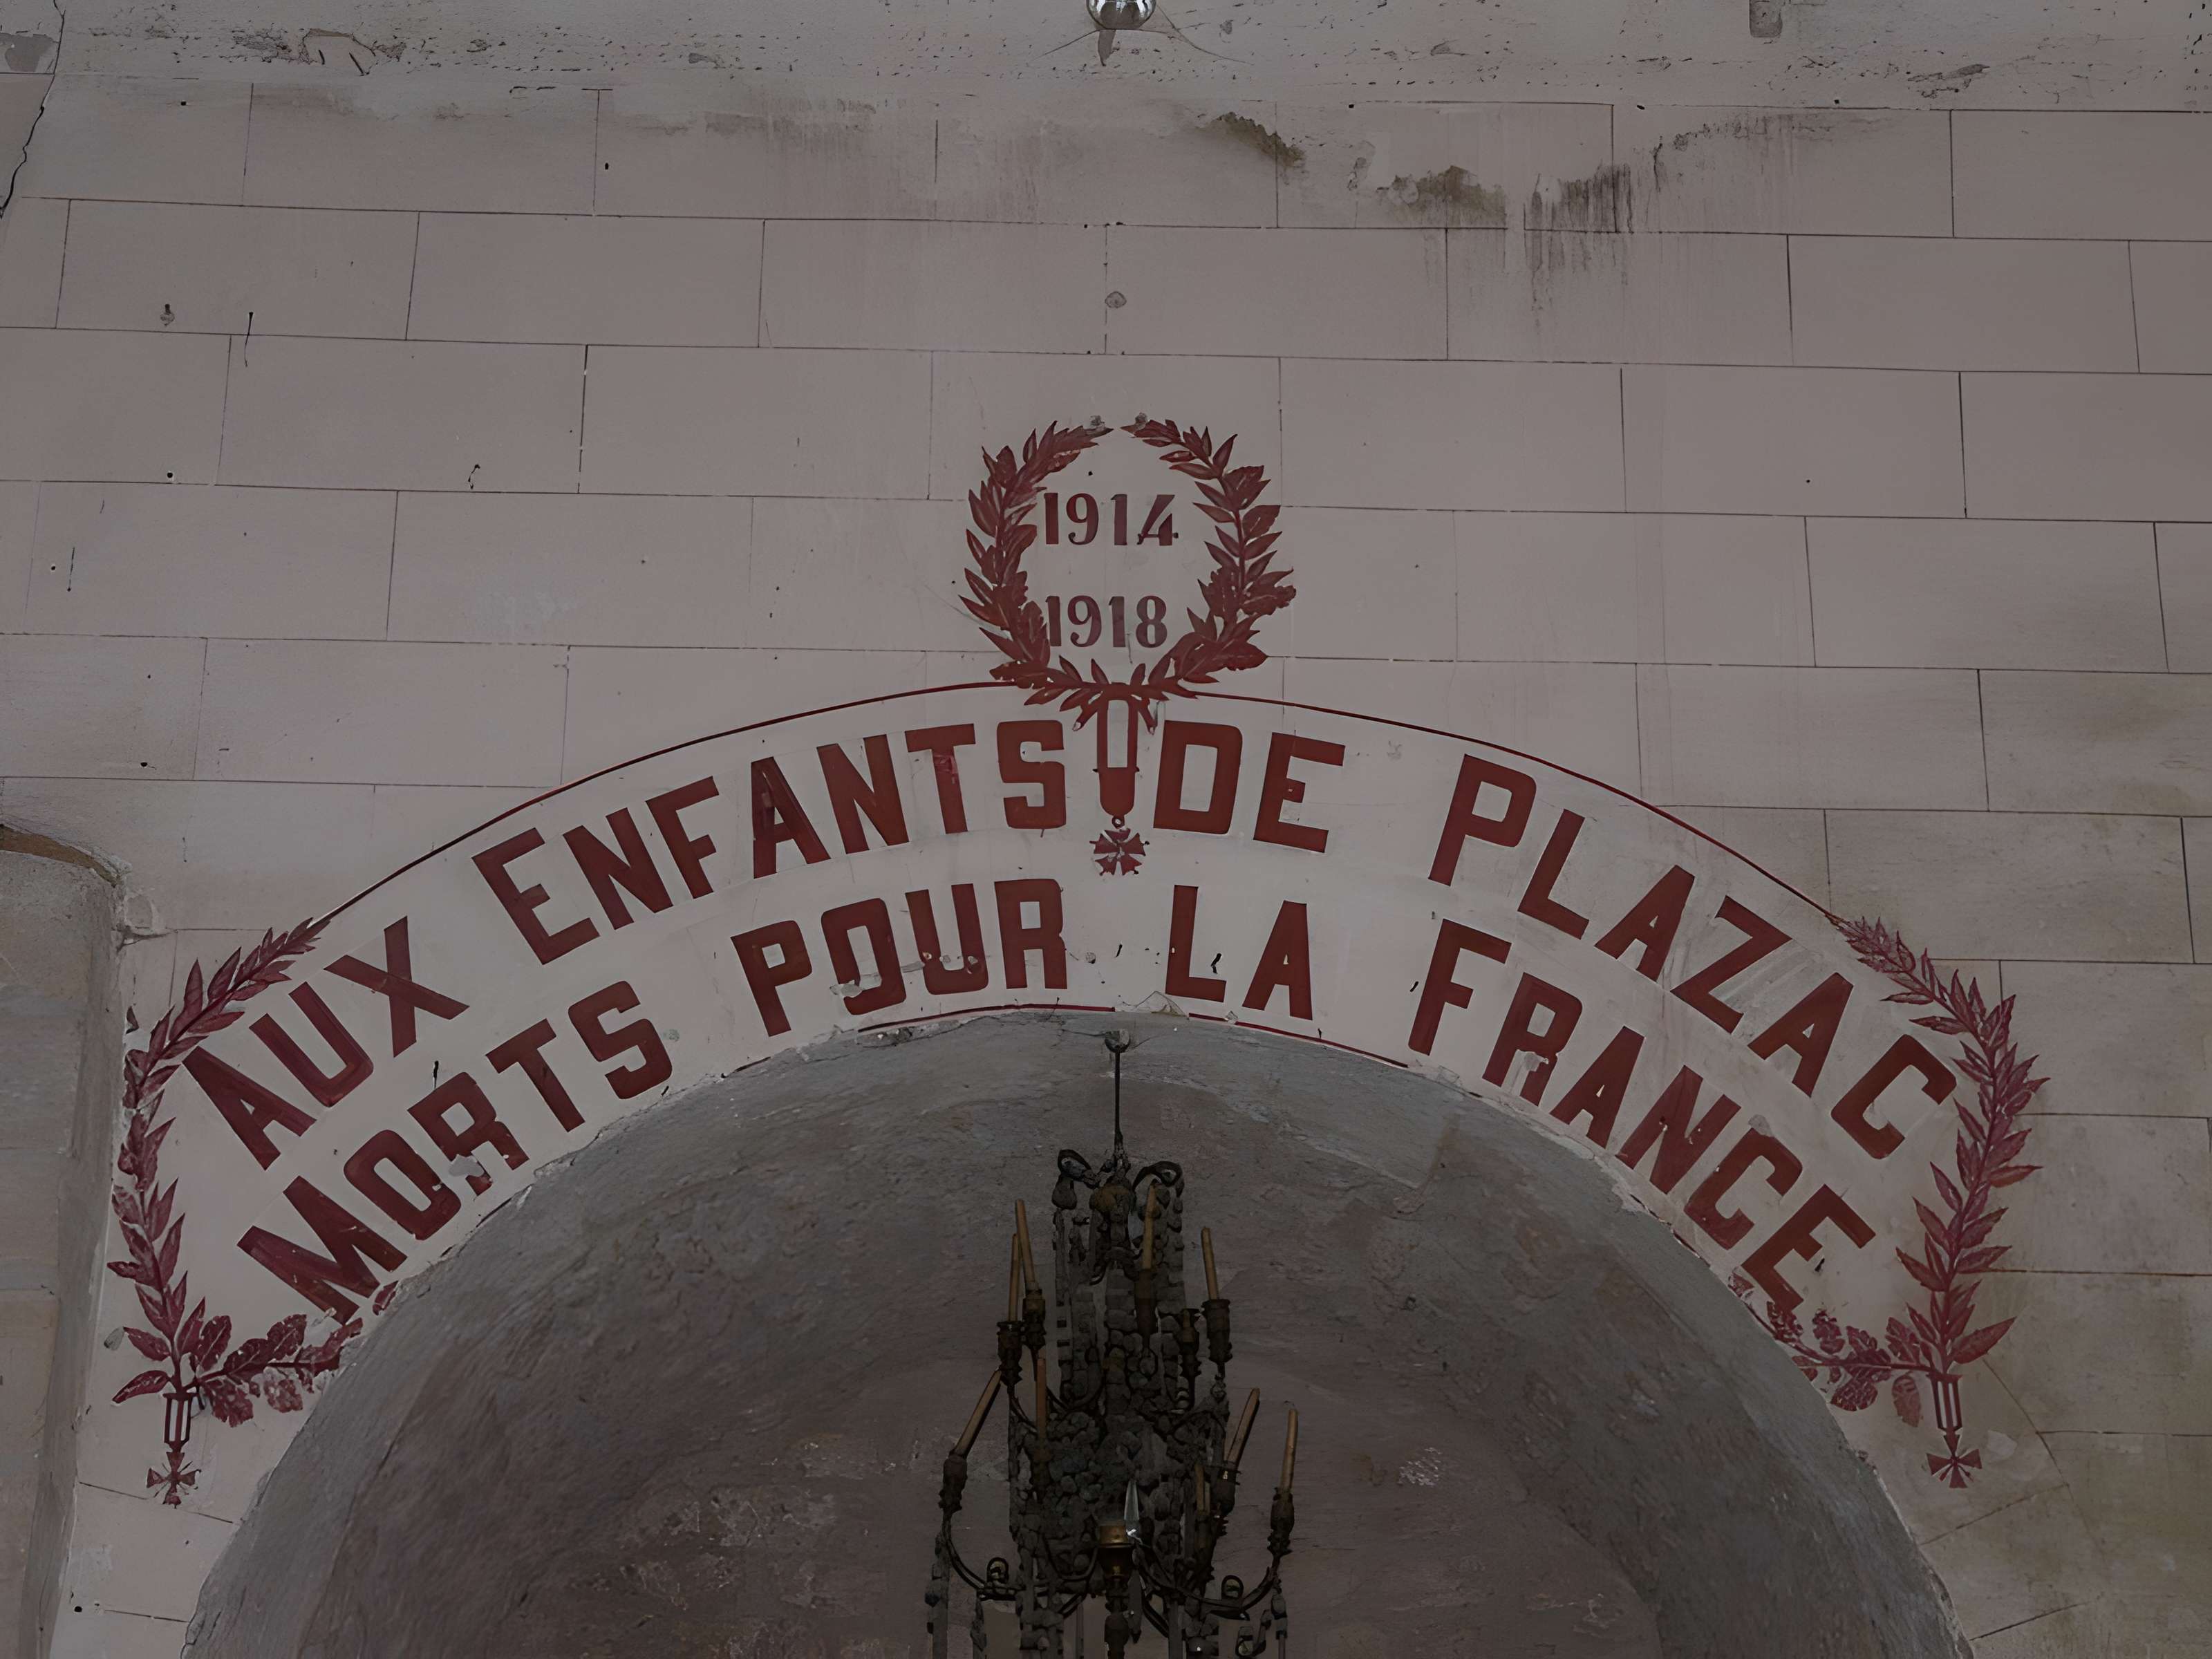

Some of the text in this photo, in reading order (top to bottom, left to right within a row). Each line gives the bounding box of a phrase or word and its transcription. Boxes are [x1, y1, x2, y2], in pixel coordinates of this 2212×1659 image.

[1044, 492, 1179, 546] 1914
[1046, 595, 1168, 648] 1918
[184, 721, 1956, 1170] AUX ENFANTS DE PLAZAC
[238, 879, 1875, 1324] MORTS POUR LA FRANCE
